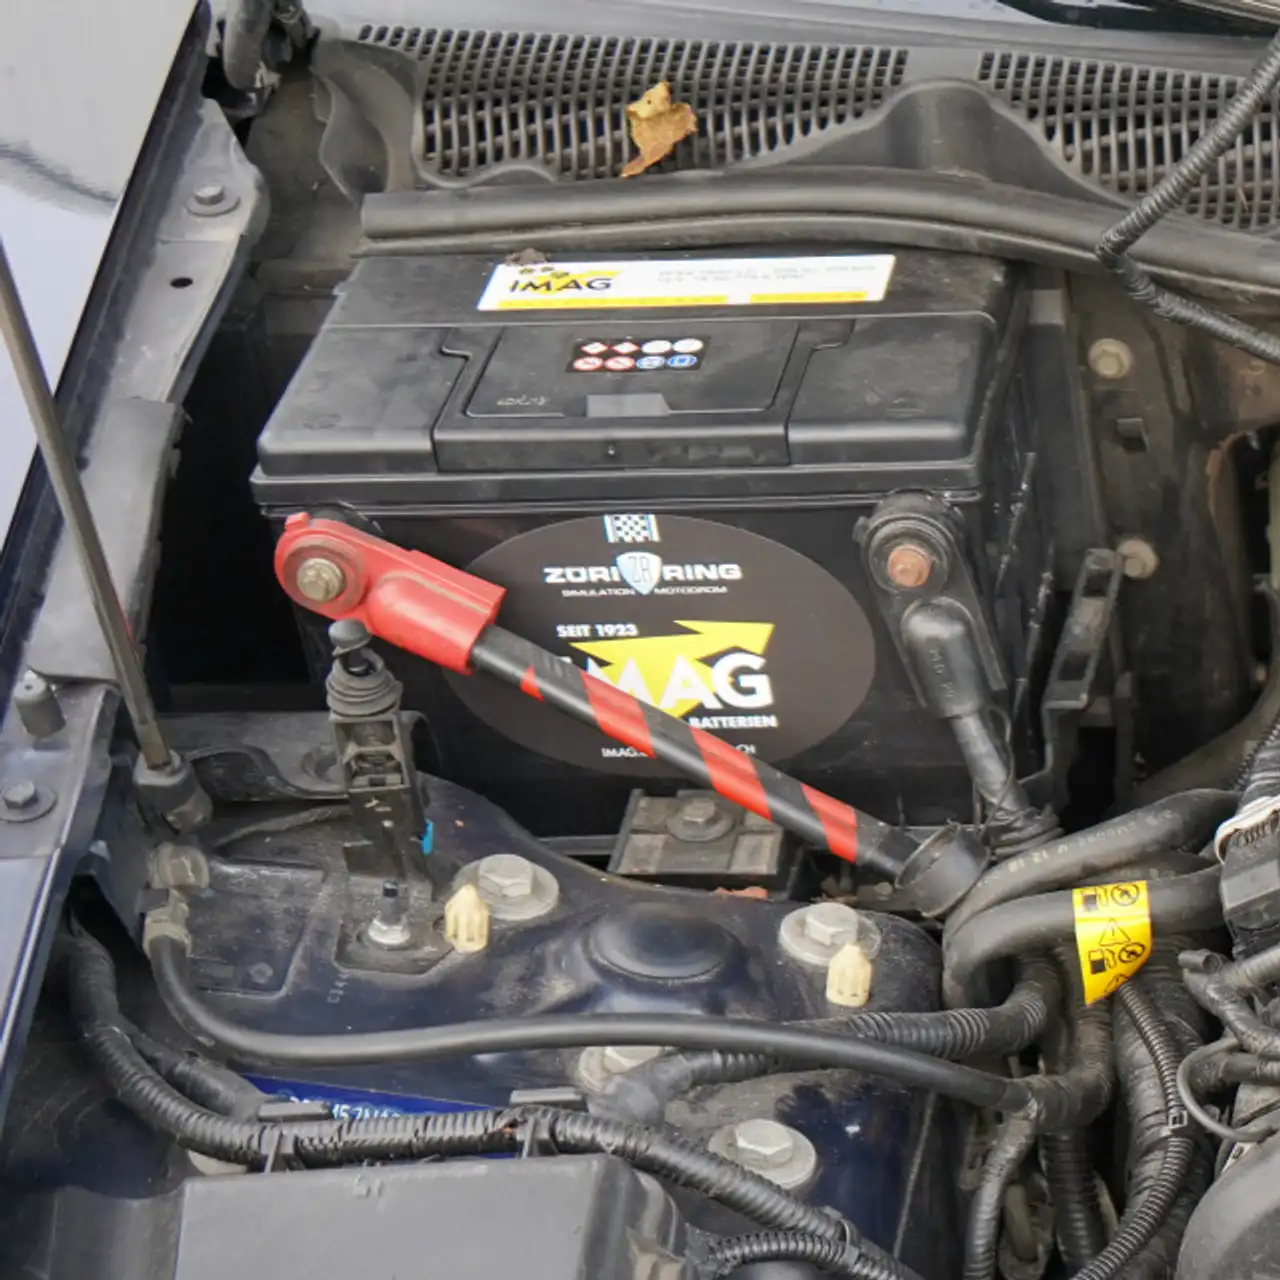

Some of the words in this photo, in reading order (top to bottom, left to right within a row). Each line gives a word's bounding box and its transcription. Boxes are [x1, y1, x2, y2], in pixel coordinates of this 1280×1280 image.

[509, 278, 613, 294] IMAG
[661, 563, 743, 581] RING
[561, 588, 636, 598] SIMULATION
[556, 624, 591, 638] SEIT
[595, 622, 640, 637] 1923
[557, 652, 774, 710] MAG
[688, 715, 778, 729] BATTERIEN
